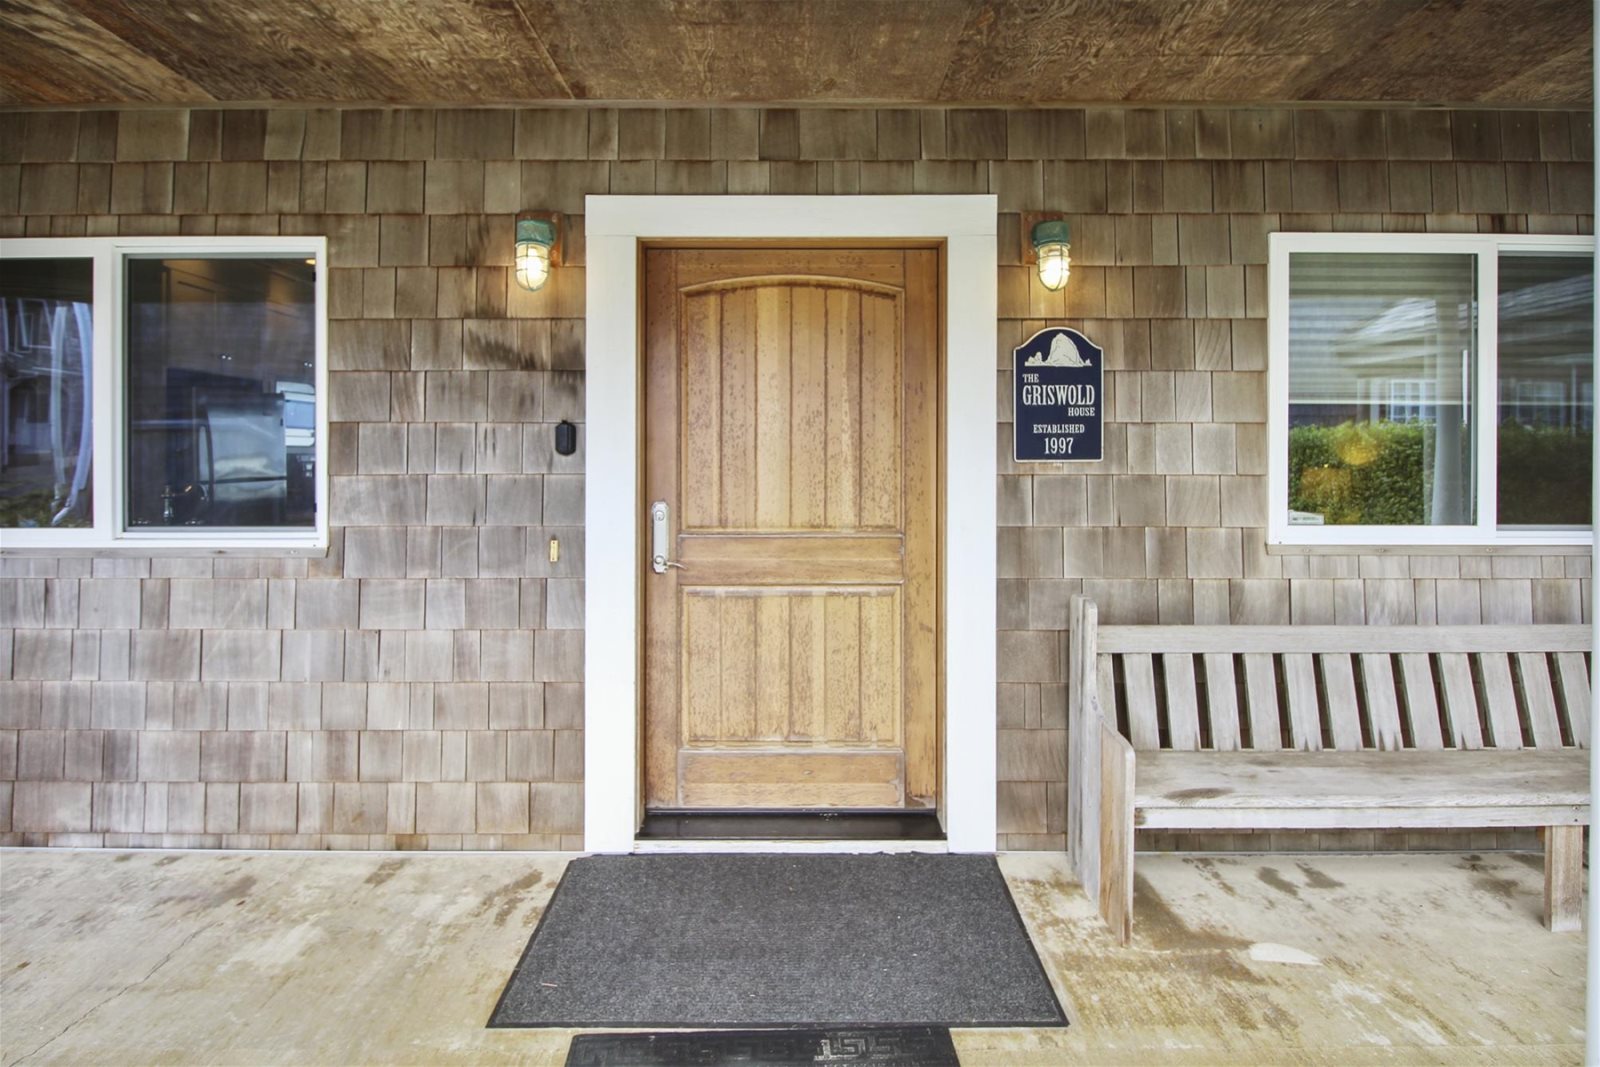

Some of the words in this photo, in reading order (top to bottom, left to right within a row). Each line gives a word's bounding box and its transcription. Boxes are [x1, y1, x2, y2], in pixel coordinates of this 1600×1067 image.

[1022, 373, 1040, 383] THE
[1022, 385, 1096, 406] GRISWOLD
[1068, 407, 1096, 417] HOUSE
[1033, 424, 1086, 434] ESTABLISHED
[1044, 437, 1074, 455] 1997
